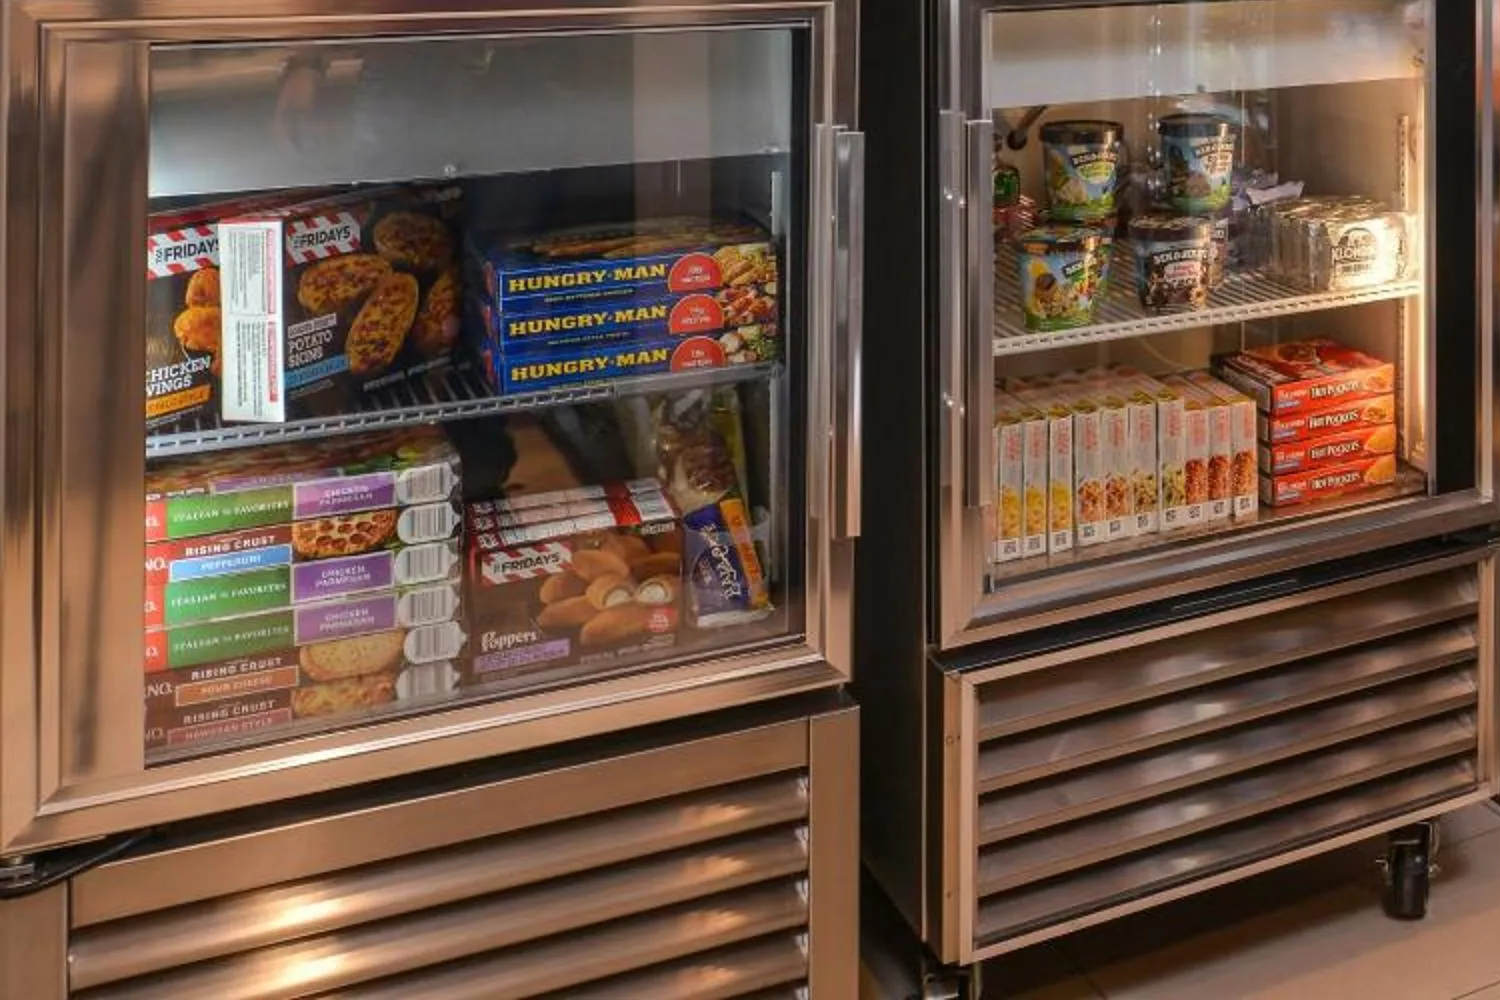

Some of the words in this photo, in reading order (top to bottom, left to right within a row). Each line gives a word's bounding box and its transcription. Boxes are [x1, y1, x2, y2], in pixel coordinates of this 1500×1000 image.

[300, 225, 351, 248] FRIDAYS
[147, 355, 211, 380] HICKEN
[234, 499, 290, 516] FAVORITES
[185, 540, 230, 557] RISING
[234, 535, 275, 549] CRUST
[501, 551, 561, 573] FRIDAYS
[231, 582, 288, 598] FAVORITES
[191, 664, 237, 681] RISING
[240, 657, 283, 673] CRUST
[183, 709, 229, 725] RISING
[233, 700, 276, 716] CRUST
